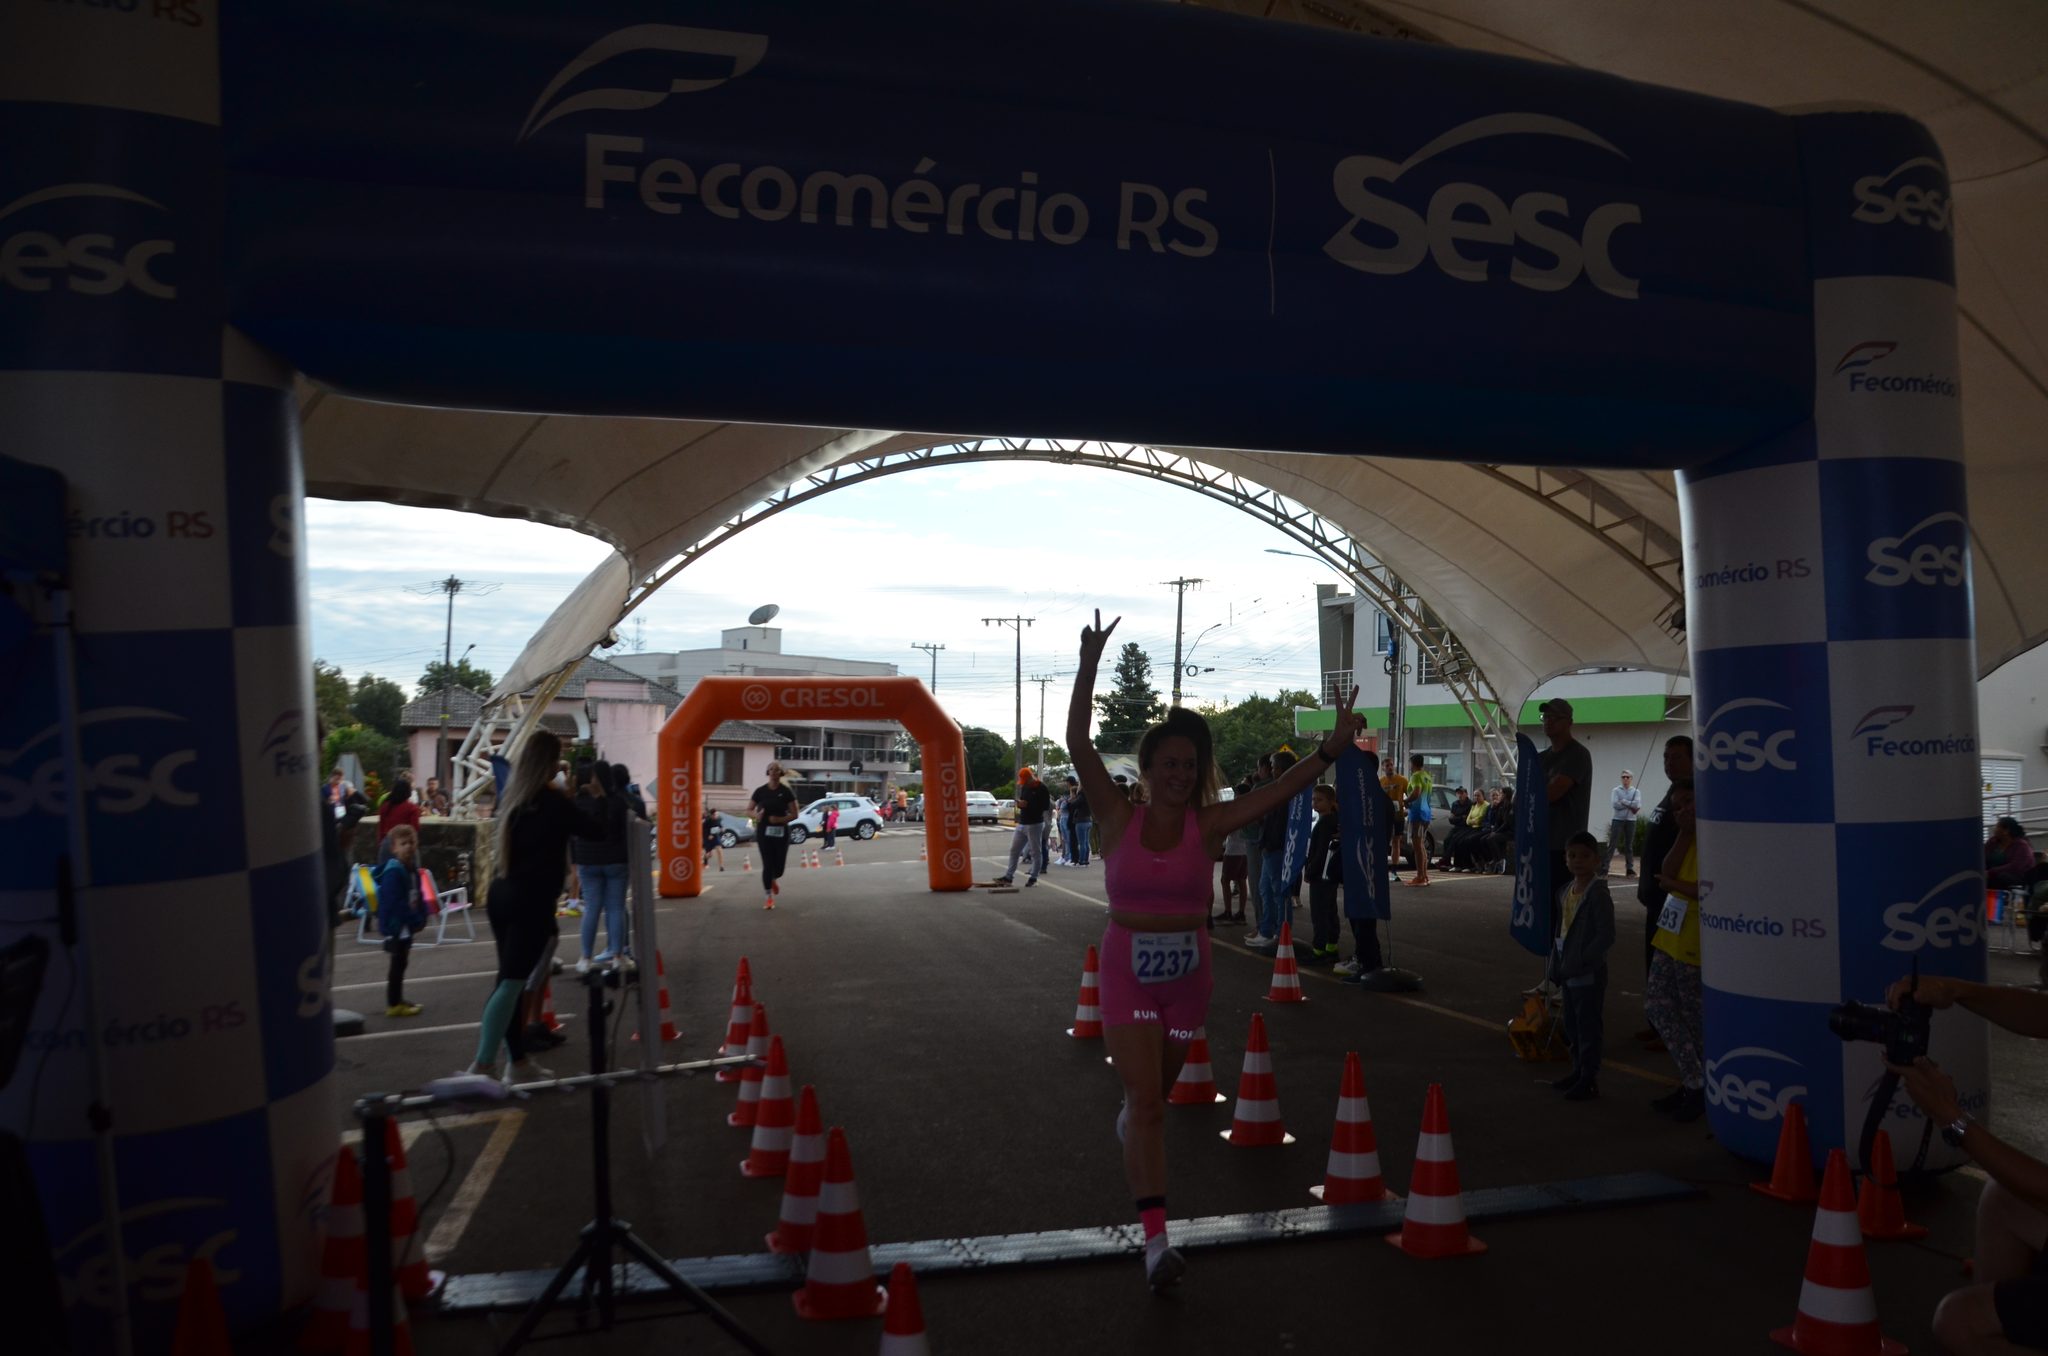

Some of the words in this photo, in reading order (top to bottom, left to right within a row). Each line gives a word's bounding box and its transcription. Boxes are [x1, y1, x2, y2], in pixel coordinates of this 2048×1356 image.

[585, 133, 1089, 245] Fecomércio
[1117, 182, 1219, 257] RS
[166, 511, 214, 538] RS
[1775, 557, 1811, 579] RS
[1864, 537, 1968, 588] Ses
[780, 687, 885, 708] CRESOL
[671, 760, 691, 849] CRESOL
[941, 755, 962, 842] CRESOL
[1658, 907, 1679, 930] 93
[1792, 917, 1827, 938] RS
[1137, 949, 1194, 977] 2237
[201, 1002, 247, 1034] RS
[1133, 1009, 1158, 1020] RUN
